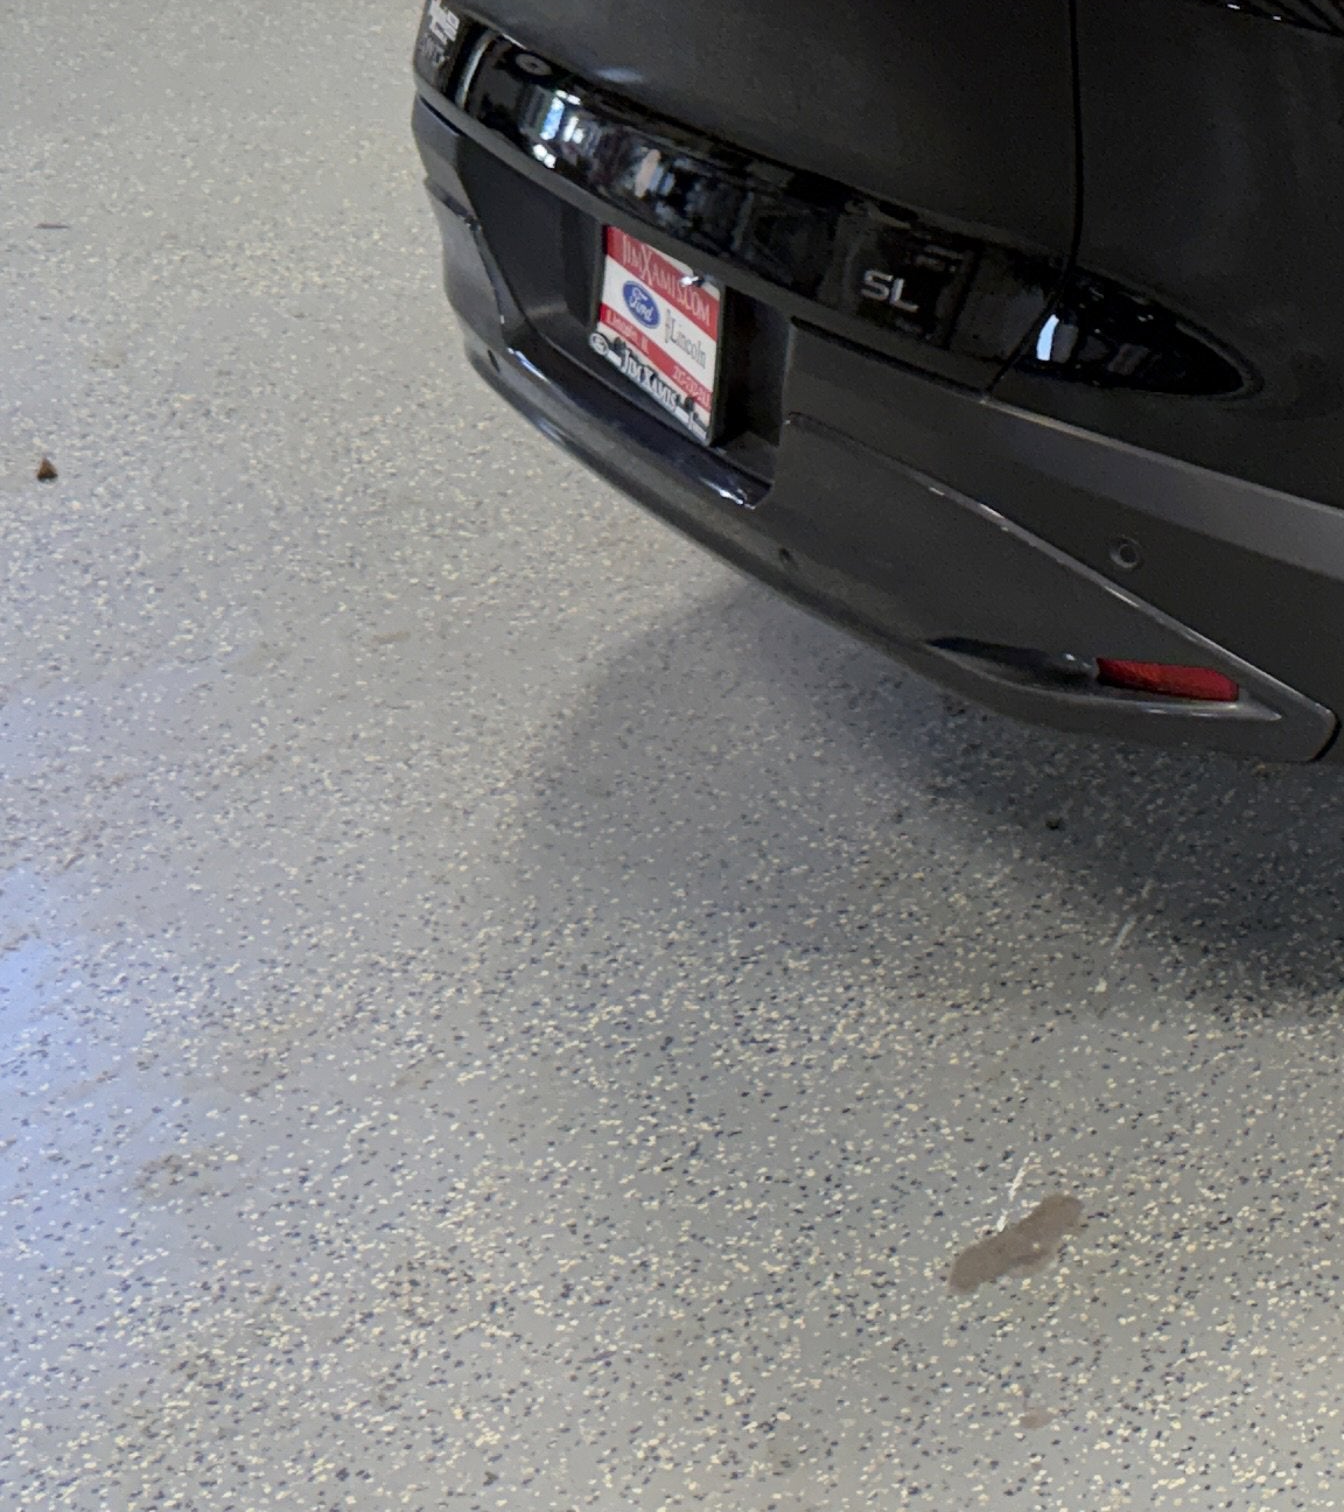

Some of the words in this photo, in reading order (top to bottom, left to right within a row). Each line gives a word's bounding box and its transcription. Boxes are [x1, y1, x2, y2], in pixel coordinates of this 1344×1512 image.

[628, 287, 655, 324] Ford
[860, 268, 920, 314] SL
[669, 314, 706, 370] Lincoln
